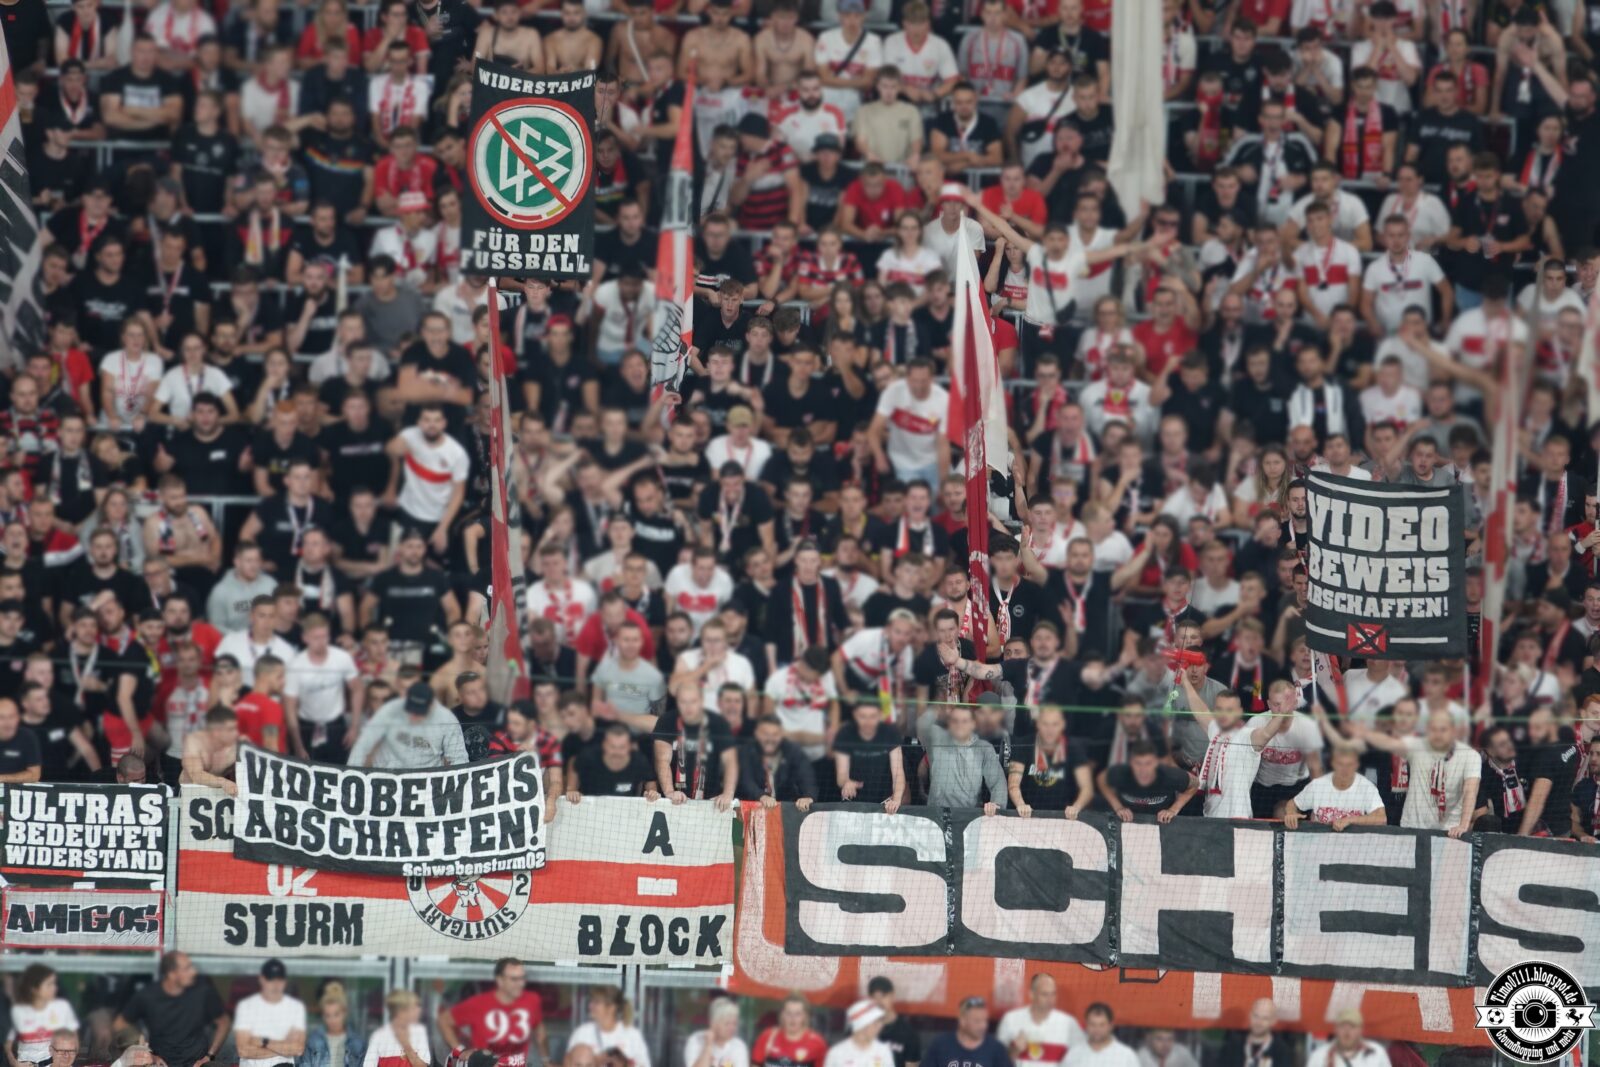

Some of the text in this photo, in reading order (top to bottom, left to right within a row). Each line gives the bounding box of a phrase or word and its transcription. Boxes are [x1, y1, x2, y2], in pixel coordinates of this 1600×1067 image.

[472, 227, 580, 253] FÜR DEN
[460, 250, 590, 273] FUSSBALL
[1307, 488, 1450, 553] VIDEO
[1308, 540, 1450, 593] BEWEIS
[244, 754, 539, 818] VIDEOBEWEIS
[9, 789, 164, 825] ULTRAS
[6, 820, 163, 850] BEDEUTET
[244, 800, 540, 856] ABSCHAFFEN!
[641, 811, 675, 857] A
[4, 844, 164, 871] WIDERSTAND
[402, 850, 546, 877] Schwabensturm02
[223, 902, 365, 948] STURM
[418, 902, 518, 940] STUTTGART
[577, 914, 727, 957] BLOCK
[484, 1008, 531, 1044] 93
